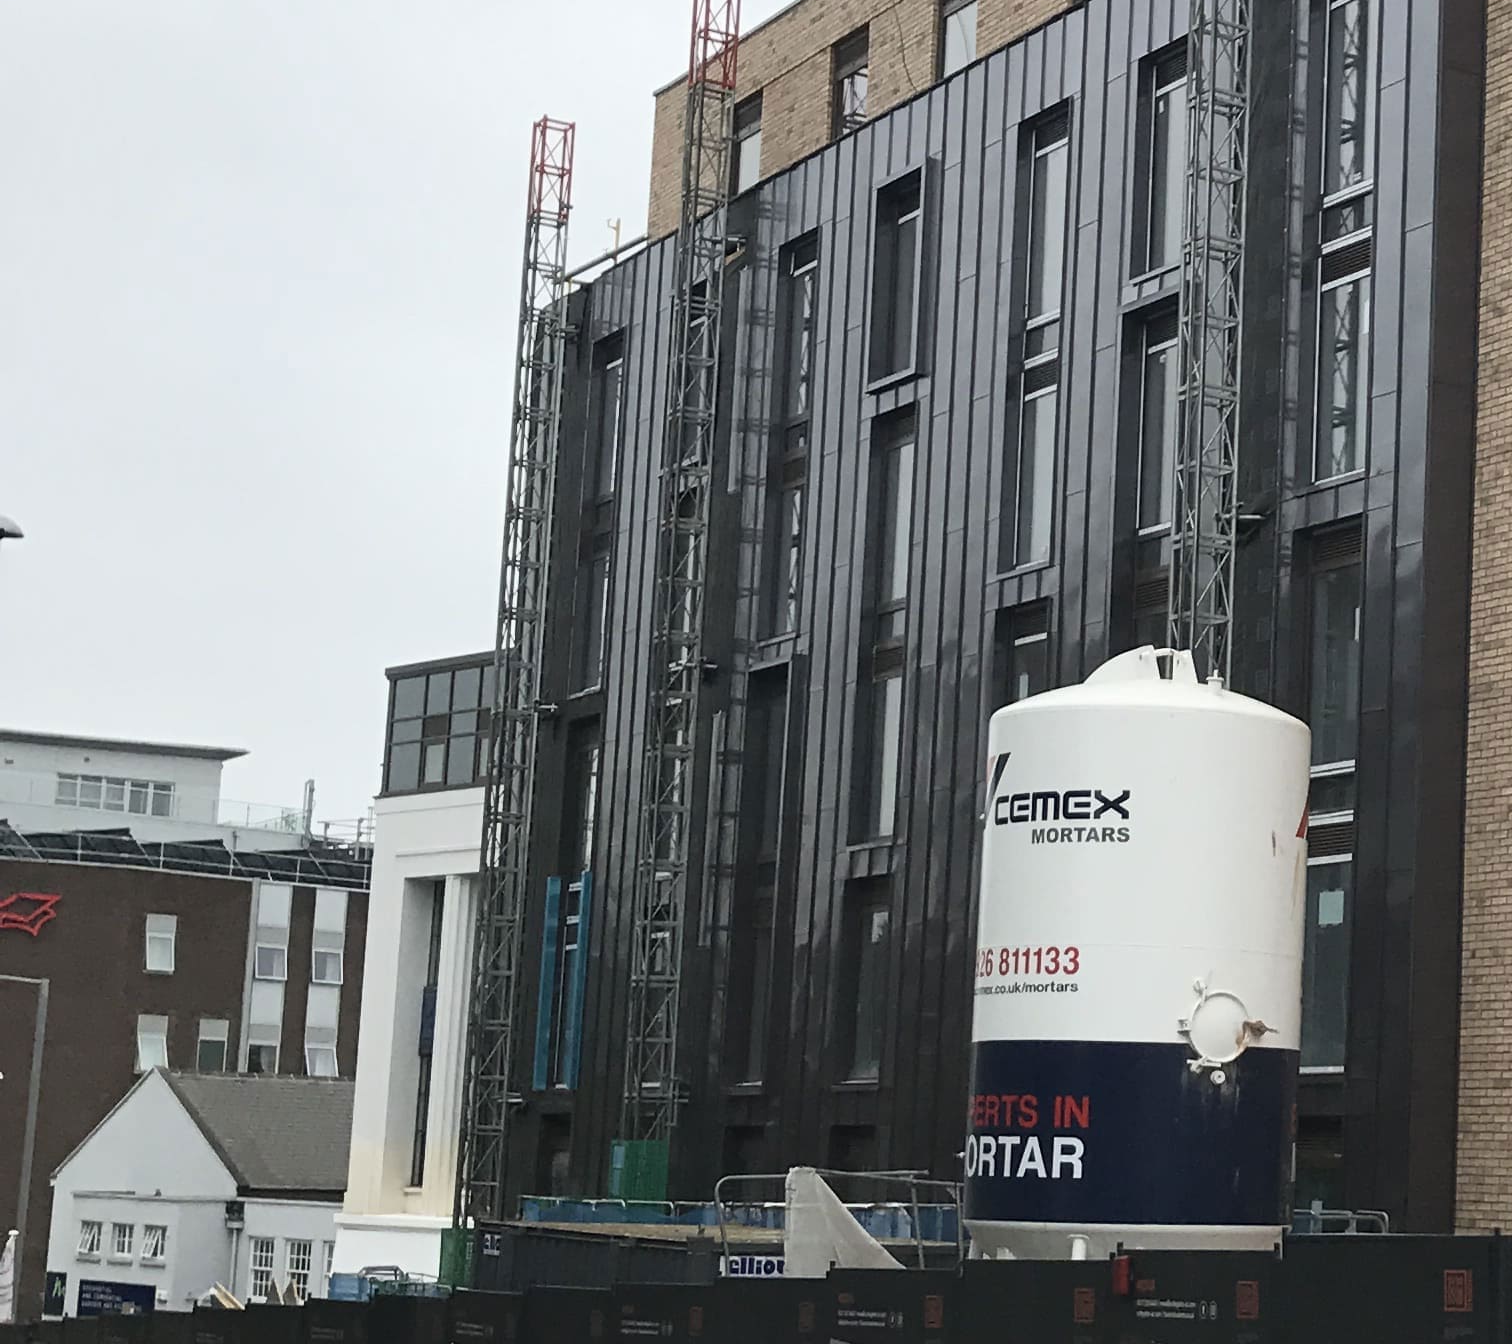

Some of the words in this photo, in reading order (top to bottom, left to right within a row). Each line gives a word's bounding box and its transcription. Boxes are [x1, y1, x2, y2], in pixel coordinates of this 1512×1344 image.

[995, 790, 1130, 825] CEMEX
[1032, 827, 1130, 844] MORTARS
[999, 947, 1079, 975] 811133
[1054, 1096, 1090, 1128] IN
